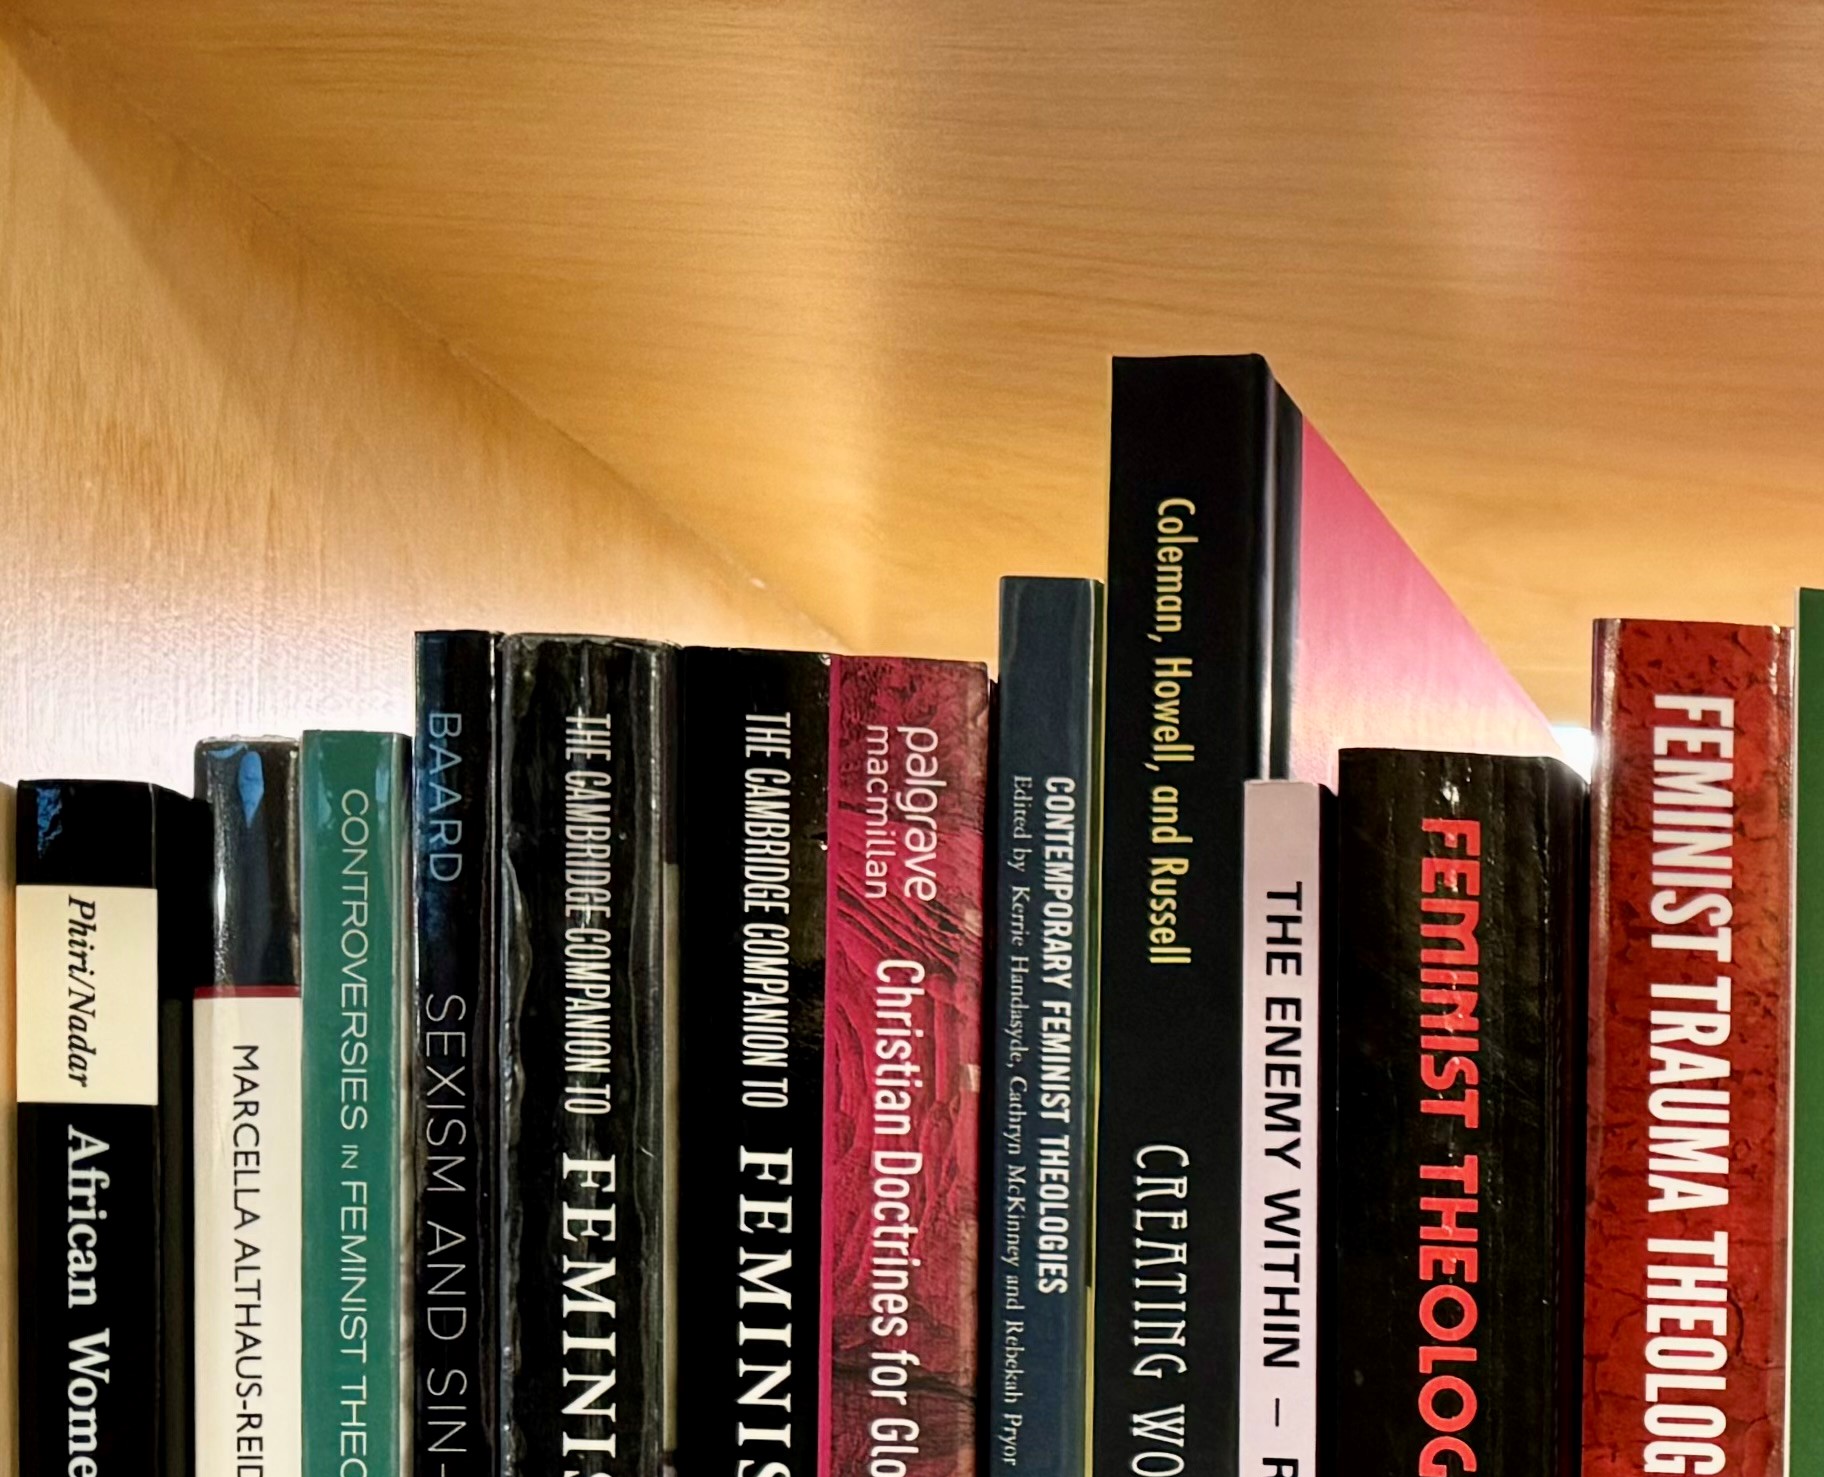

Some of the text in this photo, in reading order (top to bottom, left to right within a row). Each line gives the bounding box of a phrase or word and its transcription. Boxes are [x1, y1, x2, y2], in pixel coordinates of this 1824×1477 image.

[428, 712, 462, 883] BAARD
[566, 712, 611, 759] THE
[564, 770, 611, 923] CAMBRIDGE
[1652, 694, 1733, 963] FEMINIST
[66, 895, 97, 1088] Phiri/Nadar
[341, 788, 368, 1131] CONTROVERSIES
[564, 926, 611, 1073] COMPANION
[875, 959, 925, 1136] Christian
[1422, 818, 1480, 1131] FEMINIST
[232, 1045, 259, 1234] MARCELLA
[341, 1145, 359, 1170] IN
[425, 993, 467, 1191] SEXISM
[564, 1082, 609, 1116] TO
[1648, 984, 1731, 1213] TRAUMA
[66, 1125, 111, 1309] African
[340, 1182, 367, 1366] FEMINIST
[427, 1221, 467, 1341] AND
[873, 1151, 924, 1338] Doctrines
[1133, 1145, 1189, 1382] CREATING
[871, 1350, 920, 1405] for
